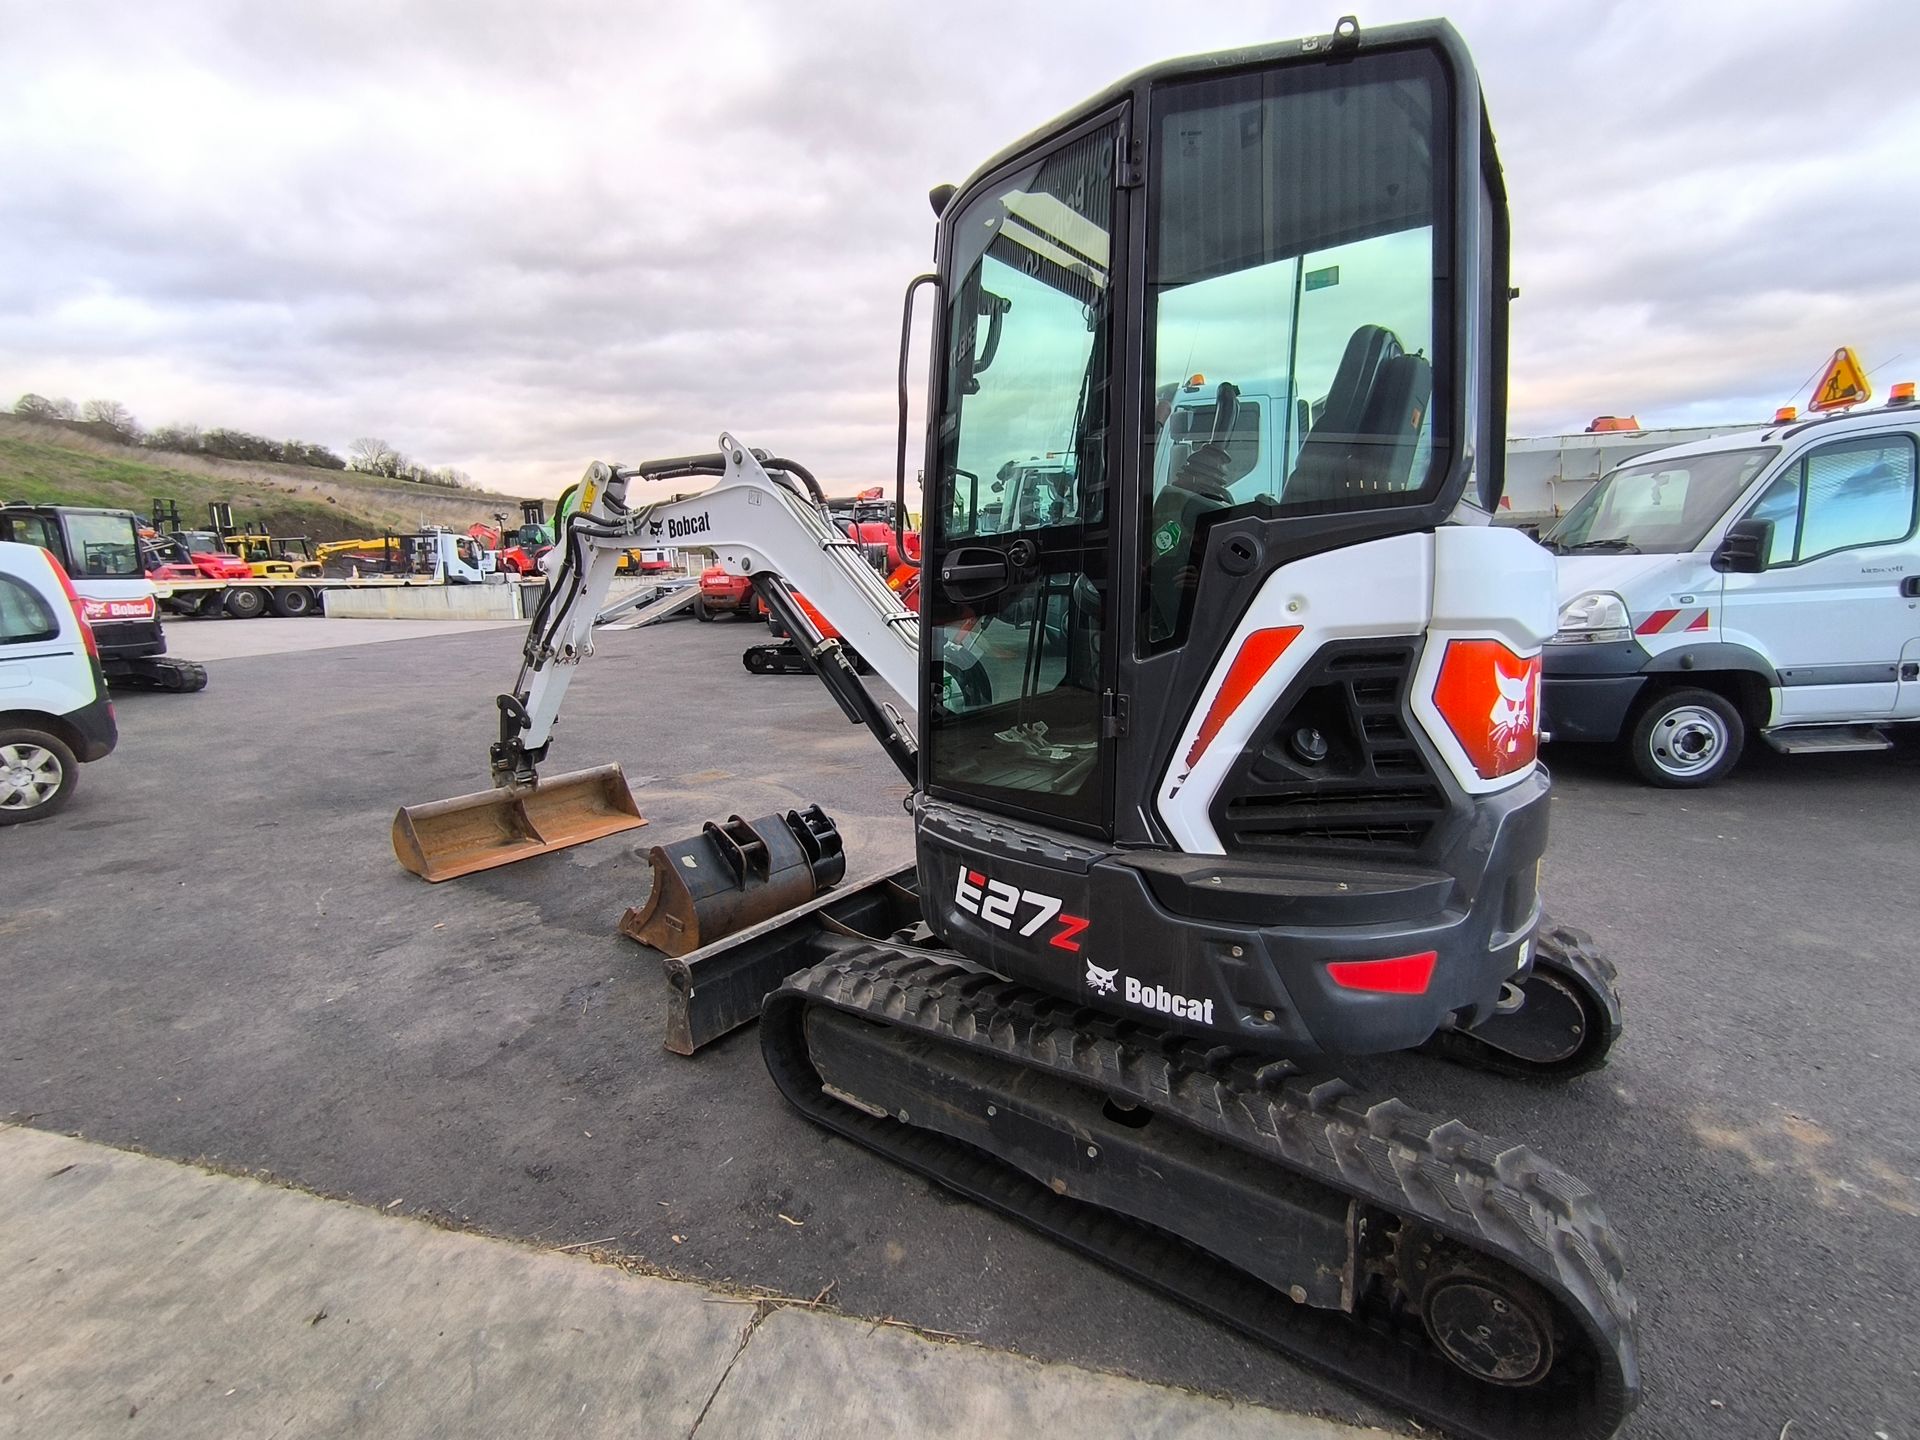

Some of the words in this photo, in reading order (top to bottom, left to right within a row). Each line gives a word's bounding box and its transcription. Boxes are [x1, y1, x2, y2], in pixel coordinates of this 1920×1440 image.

[668, 511, 710, 538] Bobcat
[110, 603, 150, 615] Bobcat
[1125, 976, 1214, 1025] Bobcat
